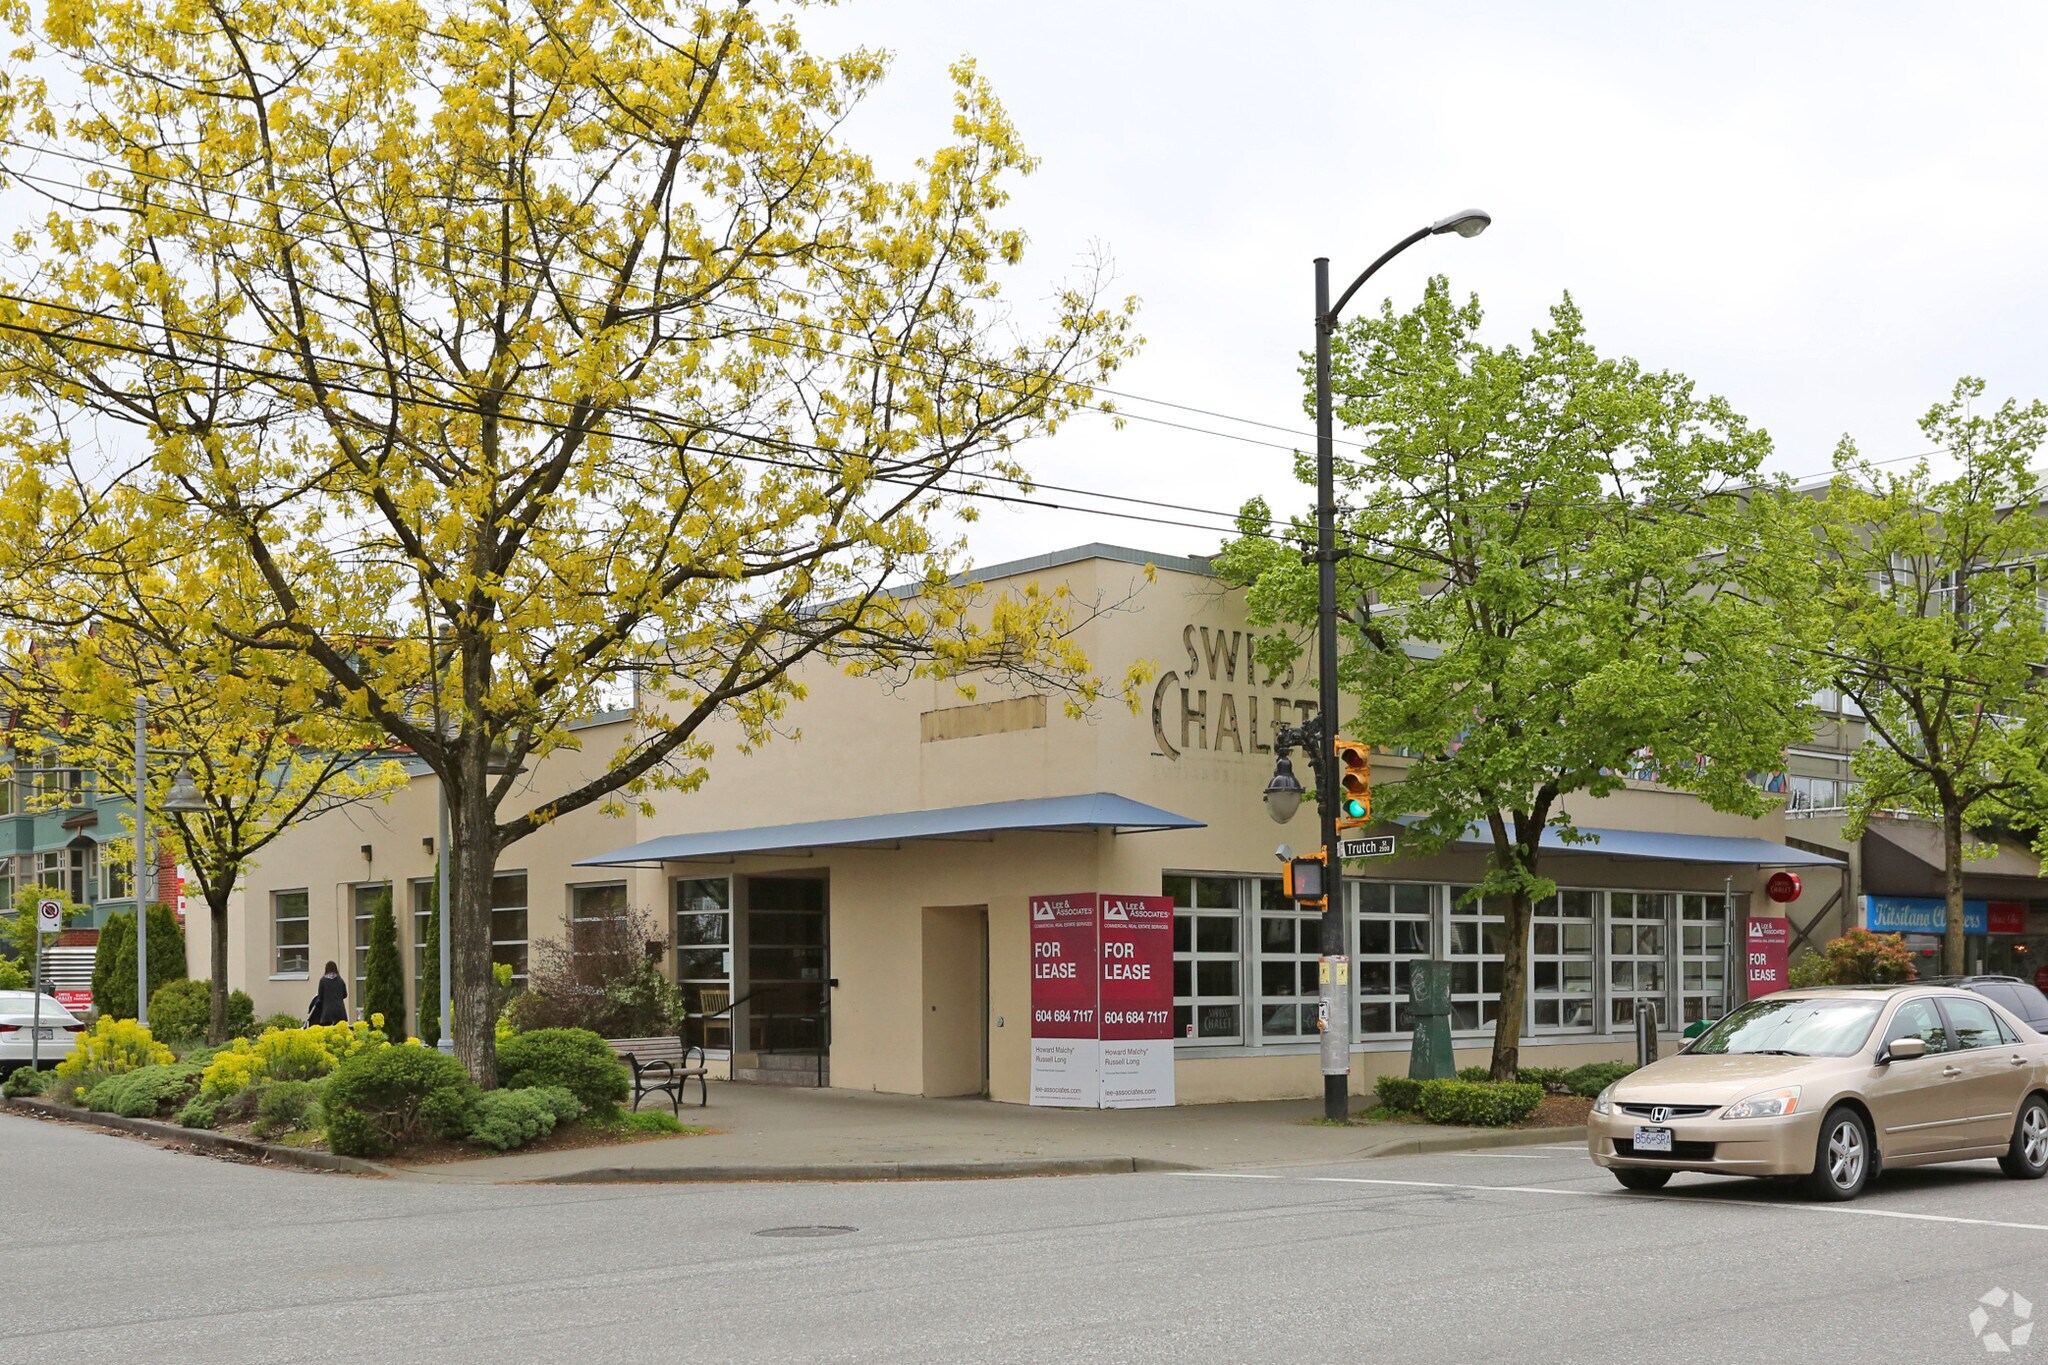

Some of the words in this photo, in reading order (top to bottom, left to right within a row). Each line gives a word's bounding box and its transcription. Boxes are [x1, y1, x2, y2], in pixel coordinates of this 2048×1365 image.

[1347, 841, 1376, 855] Trutch
[1874, 903, 1930, 927] Kitsilano
[1933, 905, 1980, 928] Clers
[1034, 942, 1061, 958] FOR
[1104, 942, 1135, 958] FOR
[1749, 953, 1767, 965] FOR
[1035, 963, 1077, 979] LEASE
[1104, 964, 1151, 980] LEASE
[1750, 969, 1776, 981] LEASE
[1035, 1010, 1052, 1022] 604
[1054, 1010, 1071, 1022] 684
[1073, 1009, 1093, 1022] 7117
[1104, 1011, 1123, 1024] 604
[1126, 1011, 1144, 1024] 684
[1147, 1011, 1168, 1023] 7117
[1054, 1056, 1067, 1064] Long
[1105, 1088, 1156, 1096] lee-associates.com
